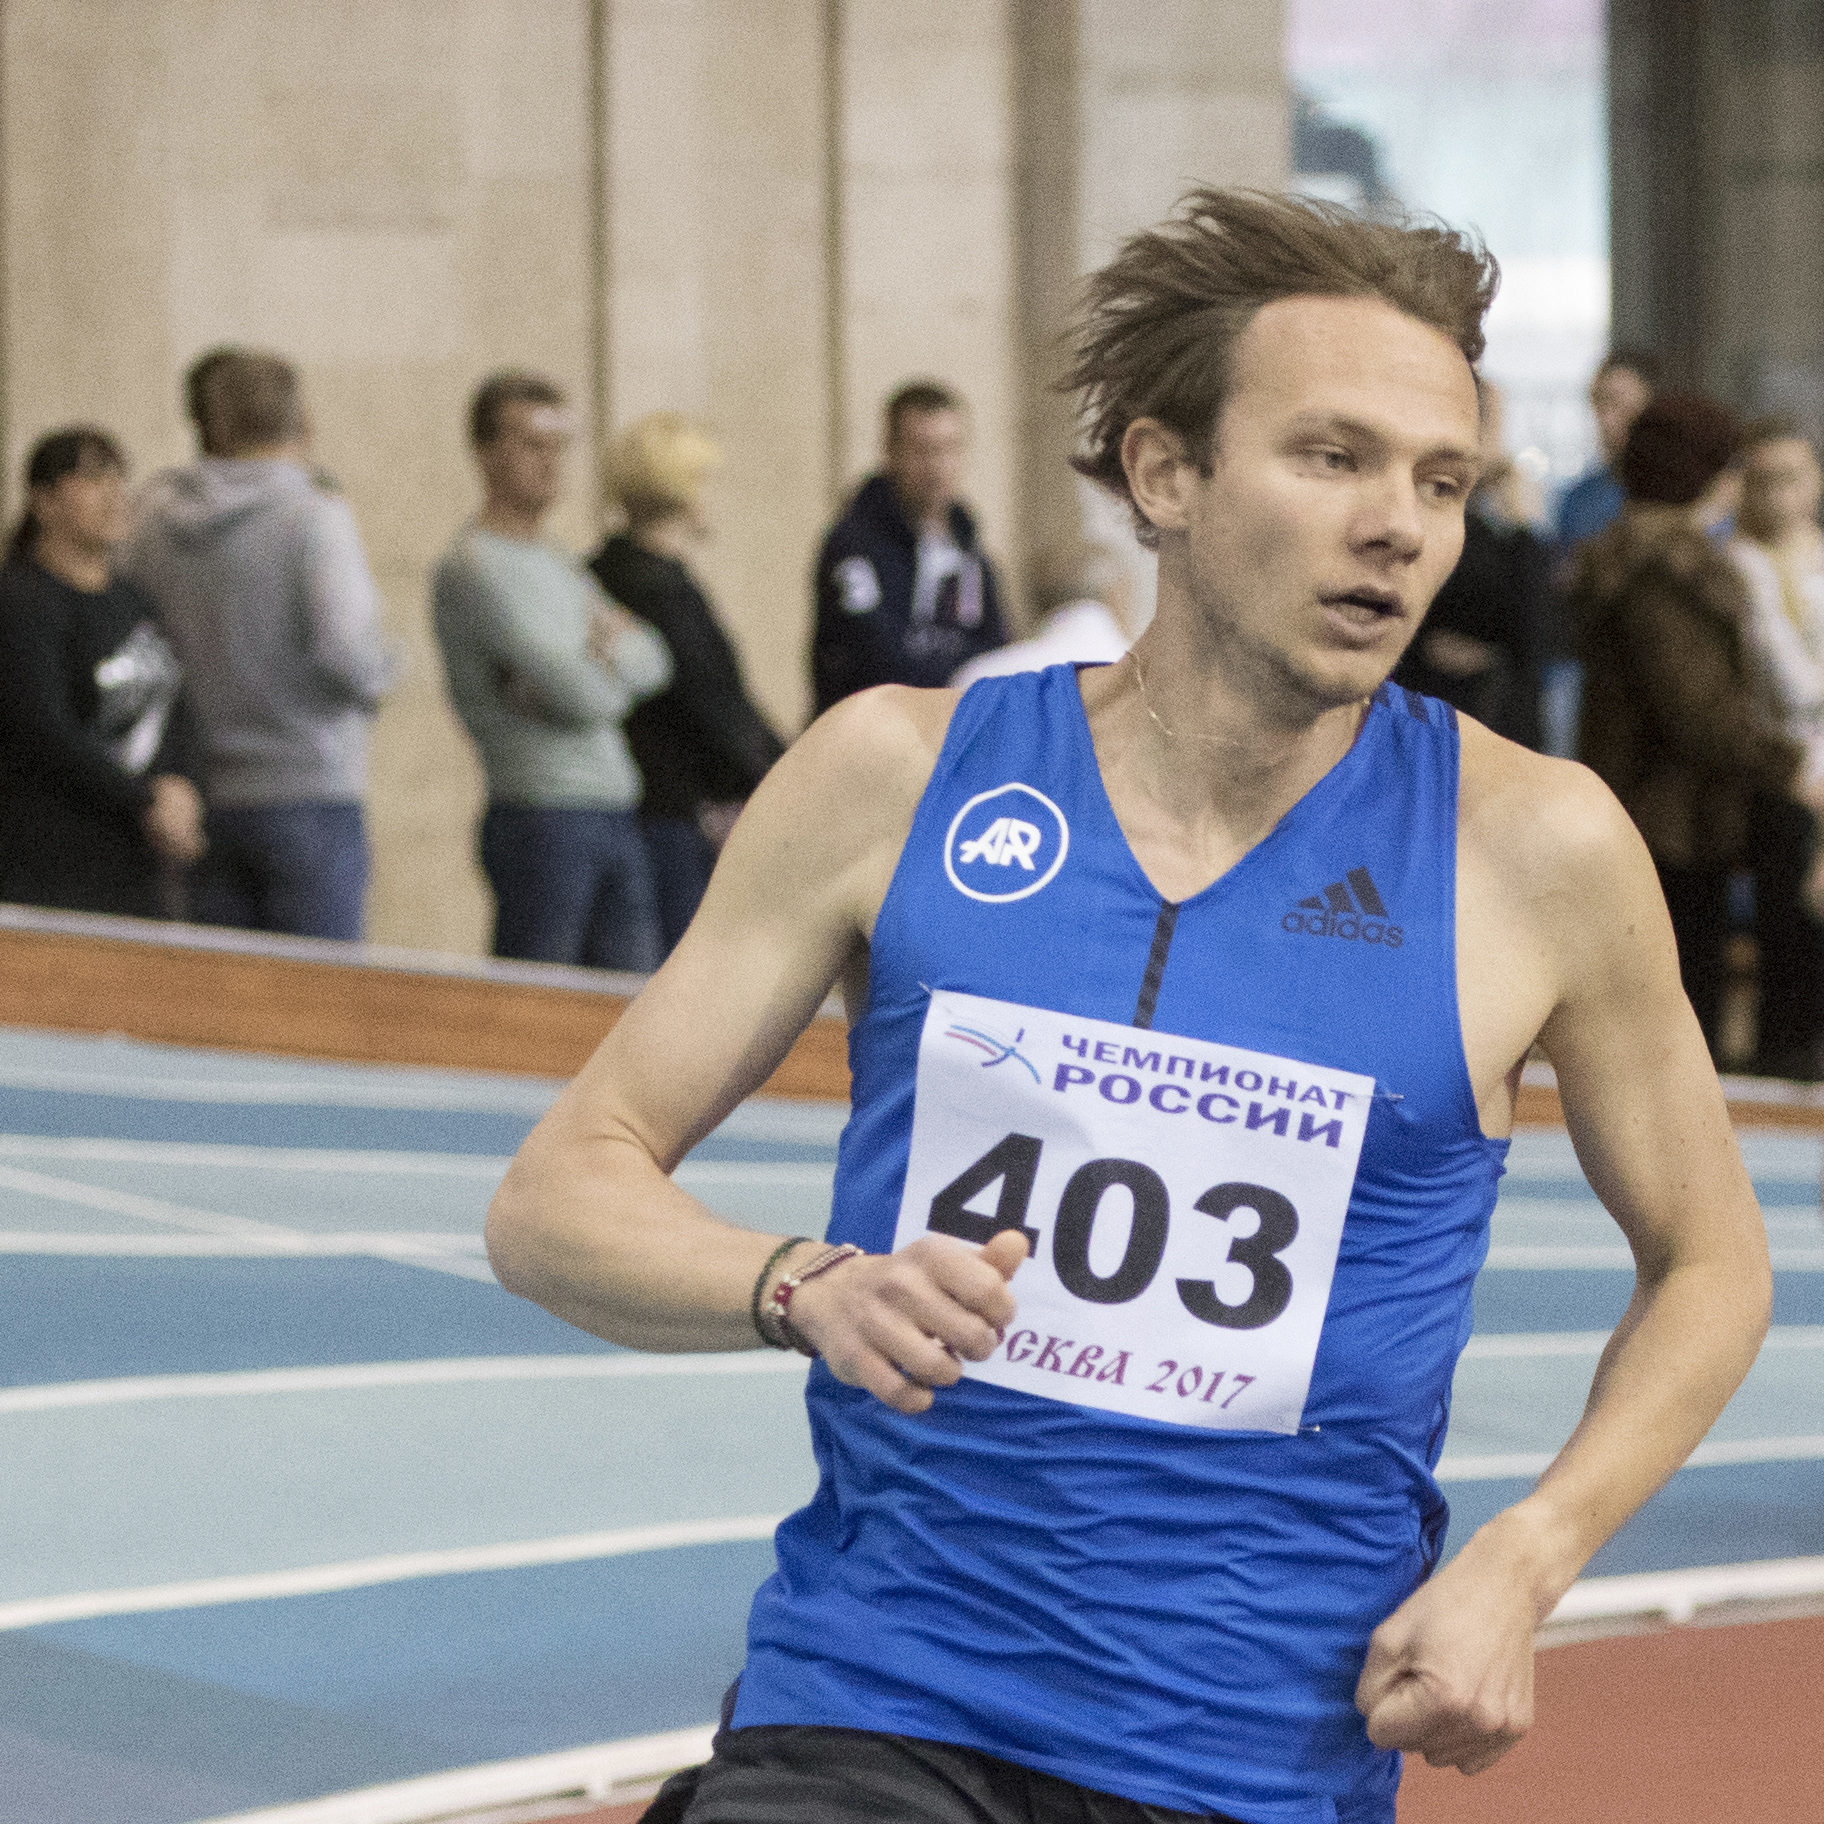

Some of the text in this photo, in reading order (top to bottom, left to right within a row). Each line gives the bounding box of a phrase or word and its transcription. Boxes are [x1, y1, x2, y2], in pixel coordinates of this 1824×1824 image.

[1281, 908, 1404, 949] adidas
[1053, 1063, 1344, 1148] РОССИИ
[1062, 1034, 1352, 1110] ЧЕМПИОНАТ
[926, 1131, 1300, 1331] 403
[996, 1326, 1257, 1410] СКВА 2017
